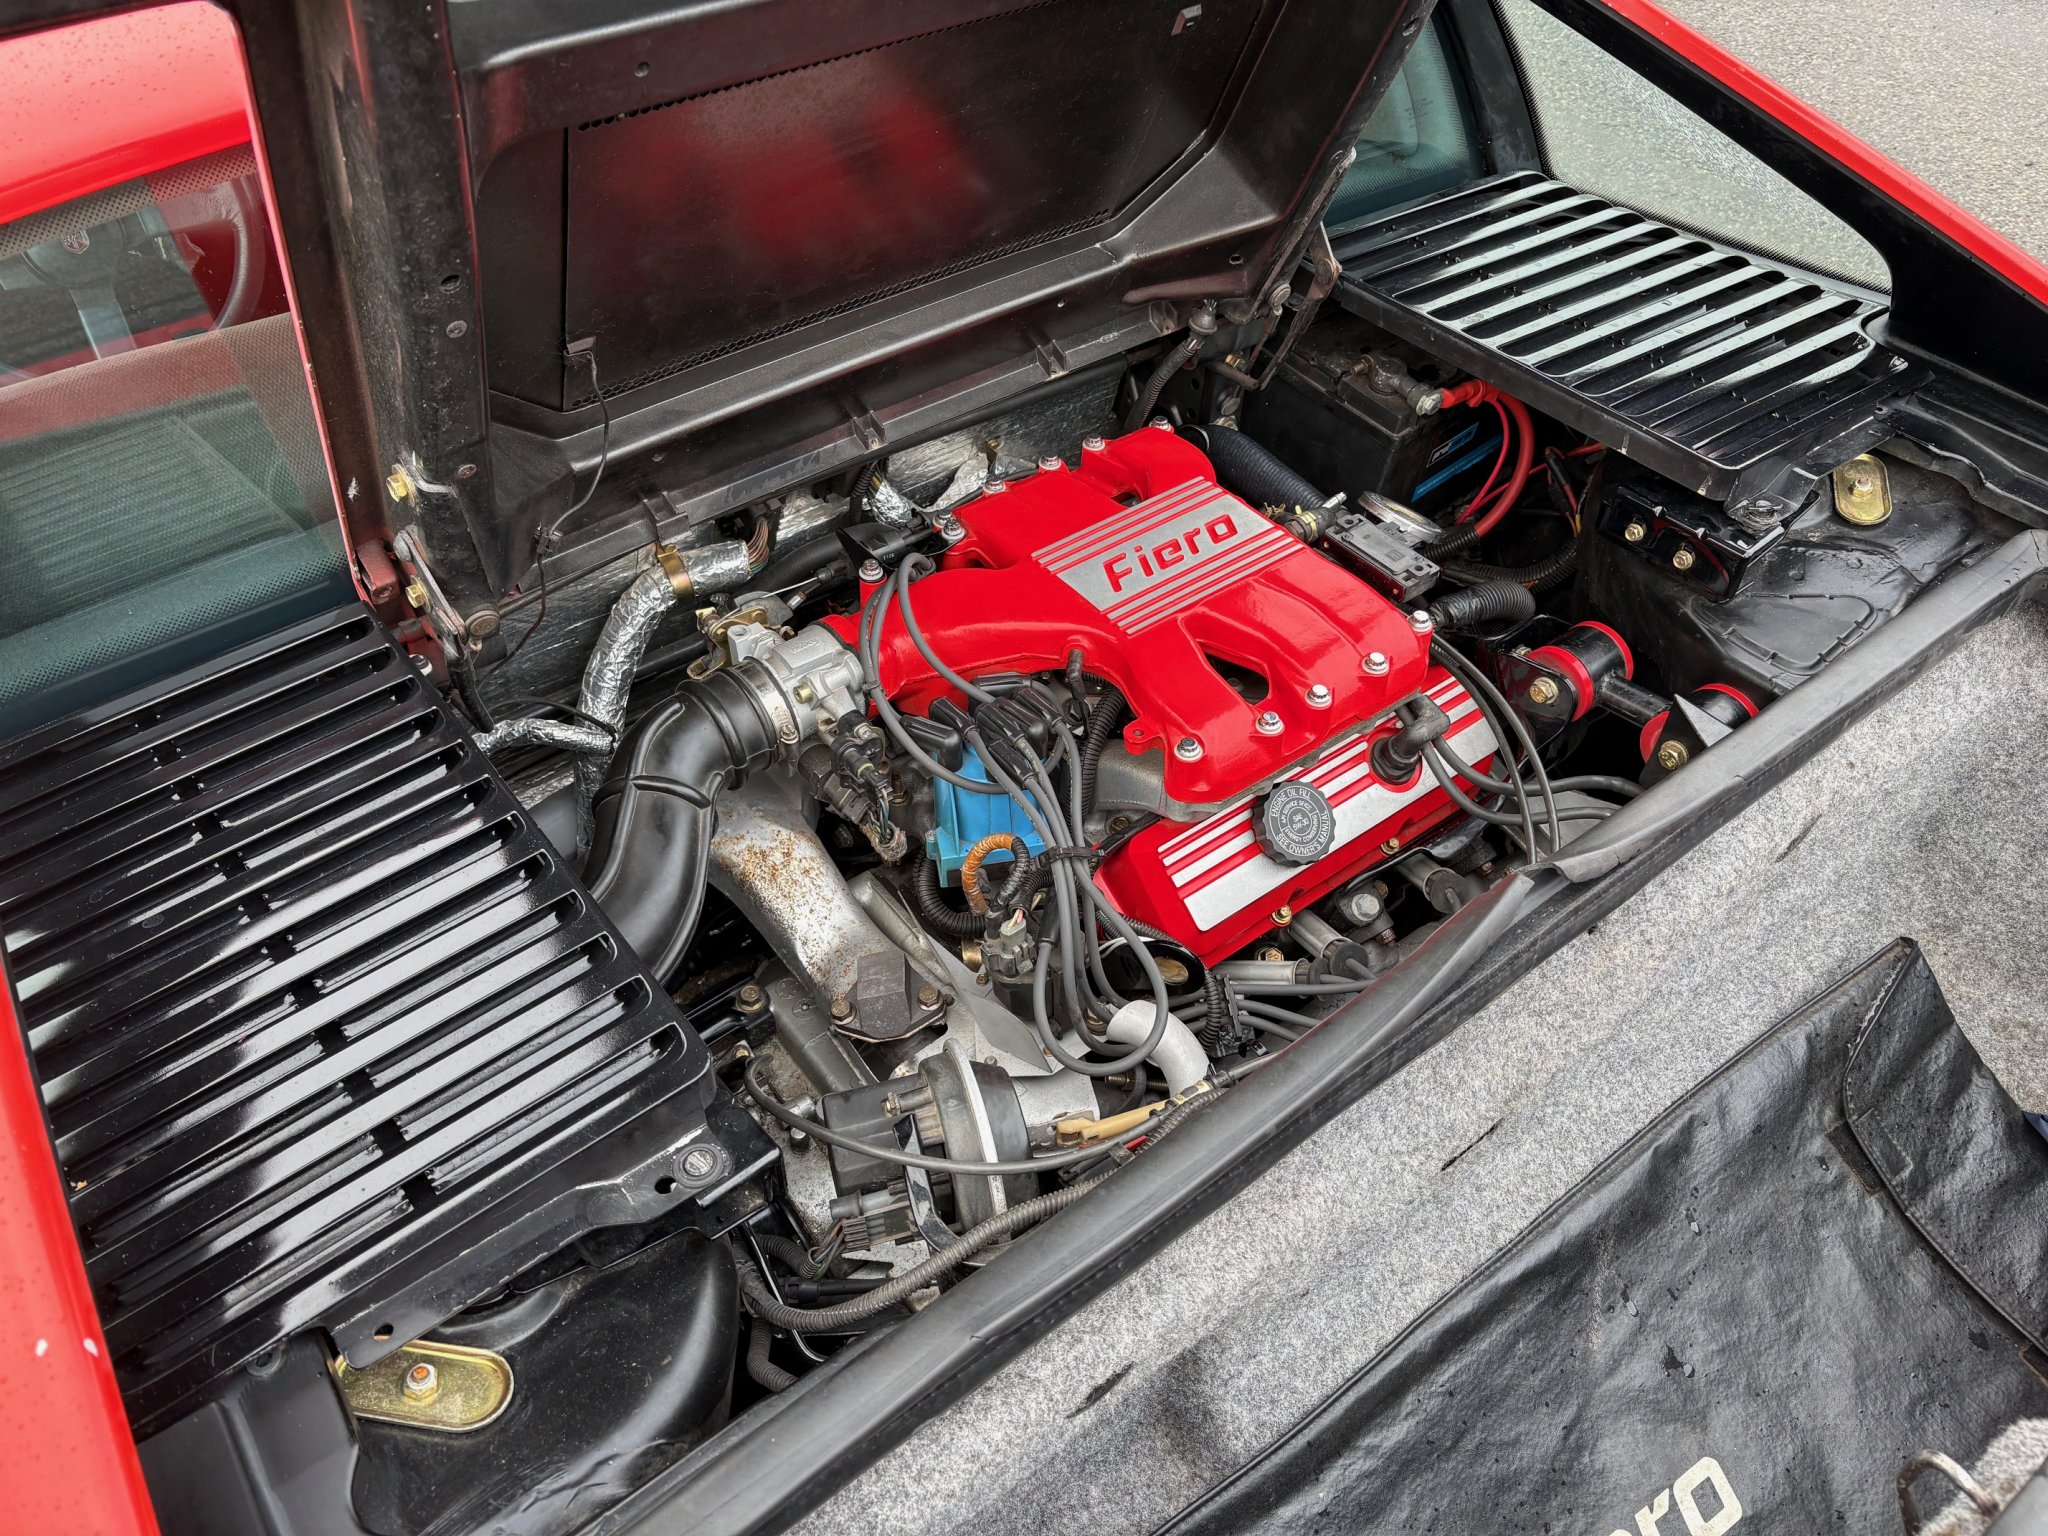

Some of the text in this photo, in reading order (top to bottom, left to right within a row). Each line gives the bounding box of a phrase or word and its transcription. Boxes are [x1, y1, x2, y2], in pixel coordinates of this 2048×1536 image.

[1103, 514, 1238, 593] Fiero
[1271, 788, 1311, 817] ENGINE OIL FILL
[1283, 800, 1298, 814] SERVICE
[1293, 813, 1303, 822] SAE
[1293, 818, 1309, 831] 5W-30
[1276, 810, 1329, 855] SEE OWNER'S MANUAL
[1608, 1456, 1743, 1536] ro
